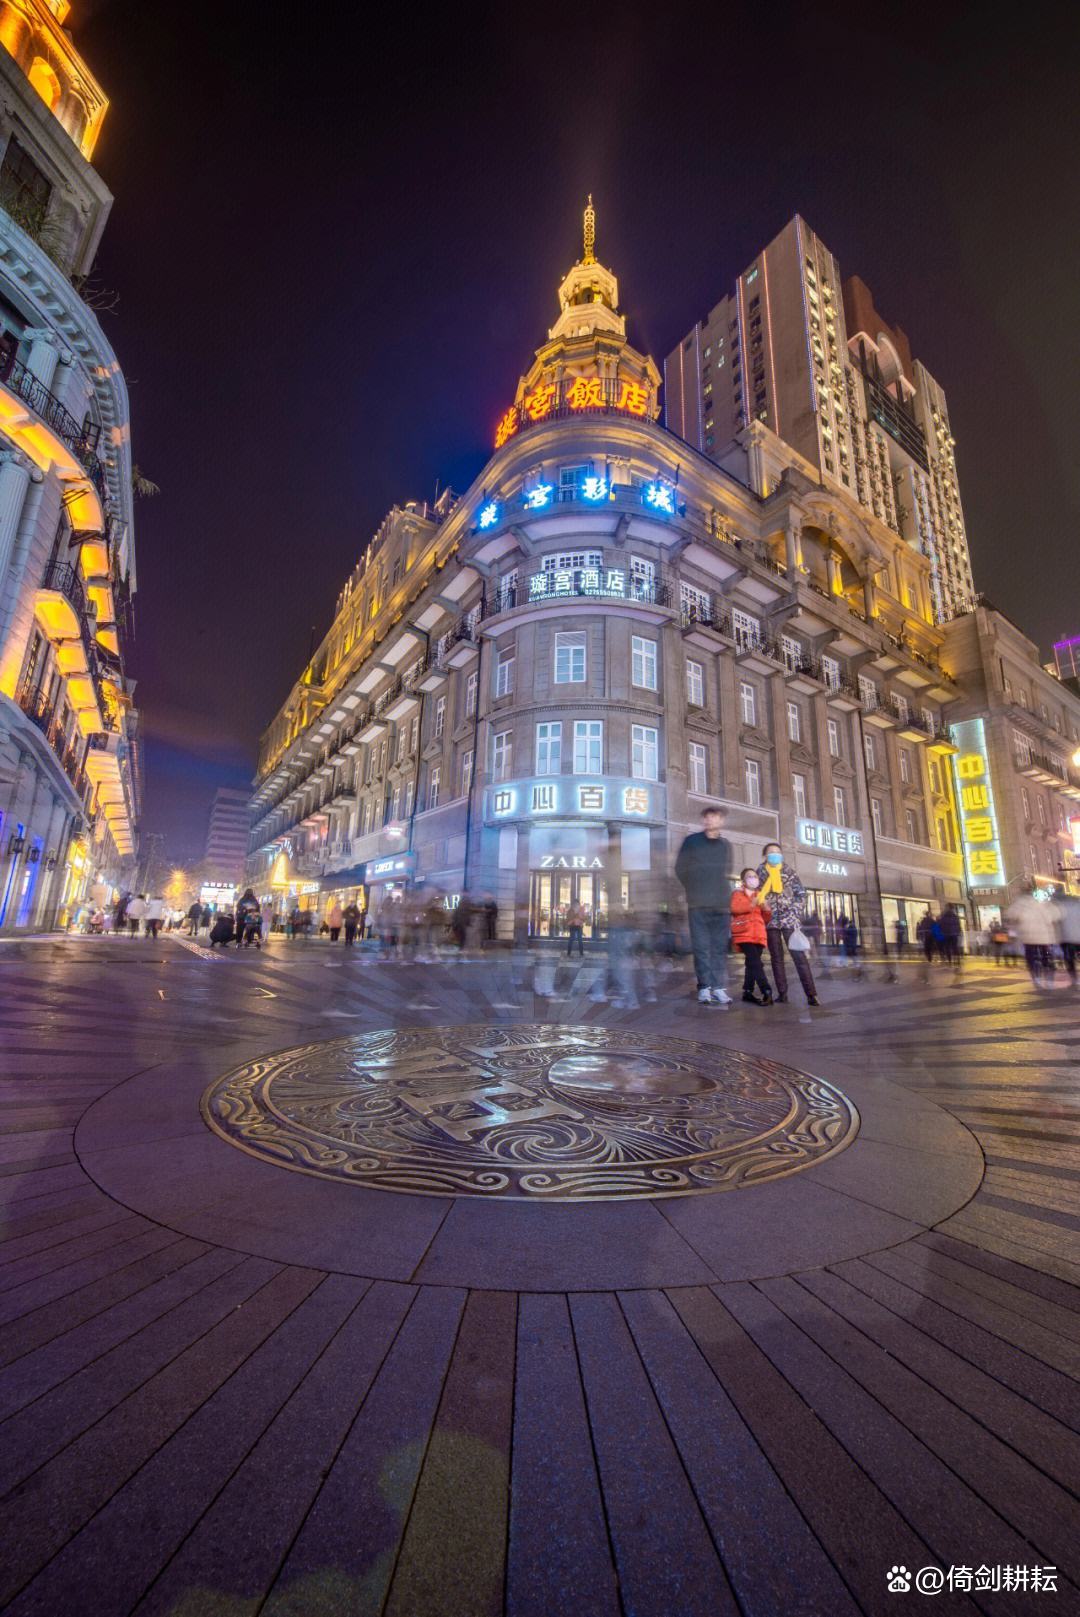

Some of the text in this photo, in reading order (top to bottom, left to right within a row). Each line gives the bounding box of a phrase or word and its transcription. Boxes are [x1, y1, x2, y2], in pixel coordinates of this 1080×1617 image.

[530, 570, 625, 594] 璇宫酒店
[494, 785, 649, 813] 中心百货
[957, 752, 1000, 876] 中心百货
[804, 825, 862, 853] 中心百货
[541, 856, 605, 868] ZARA
[818, 862, 848, 876] ZARA
